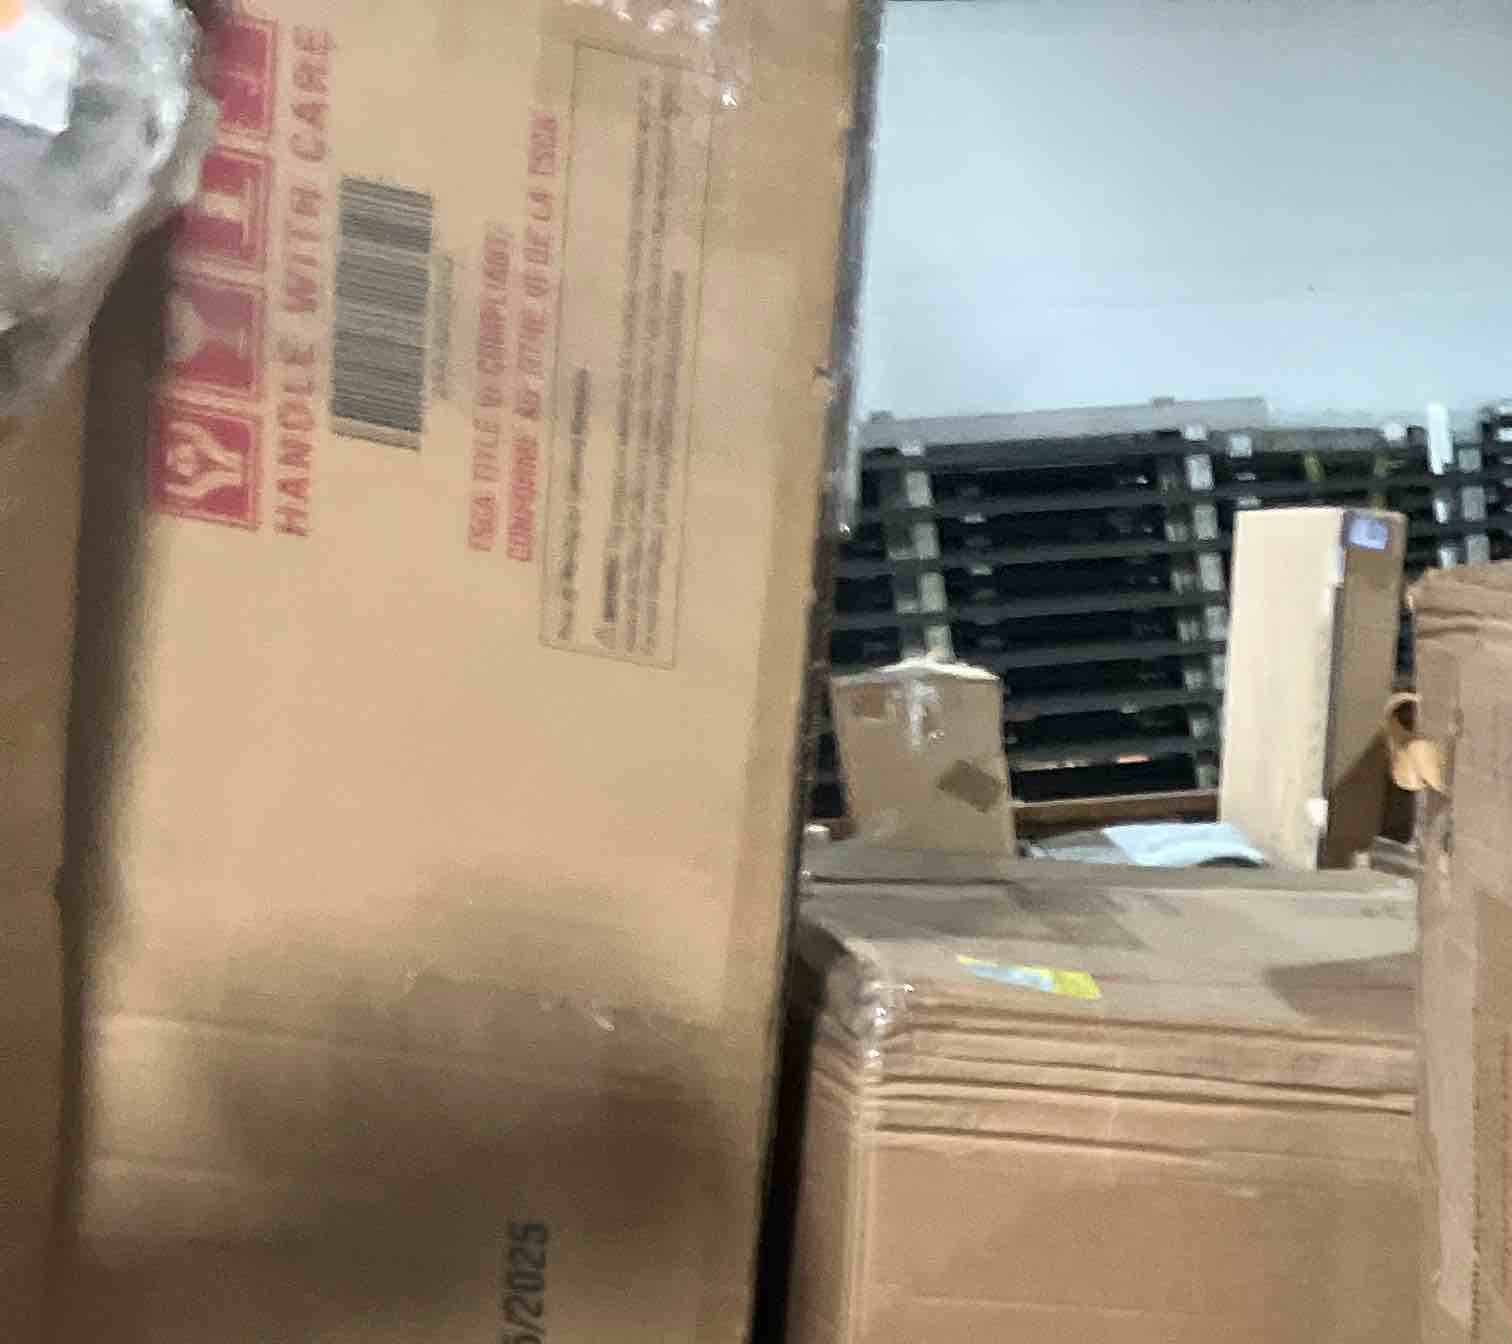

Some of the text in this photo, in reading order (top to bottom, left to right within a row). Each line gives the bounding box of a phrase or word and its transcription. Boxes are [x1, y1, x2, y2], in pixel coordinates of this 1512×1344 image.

[273, 26, 331, 538] HANDLE WITH CARE
